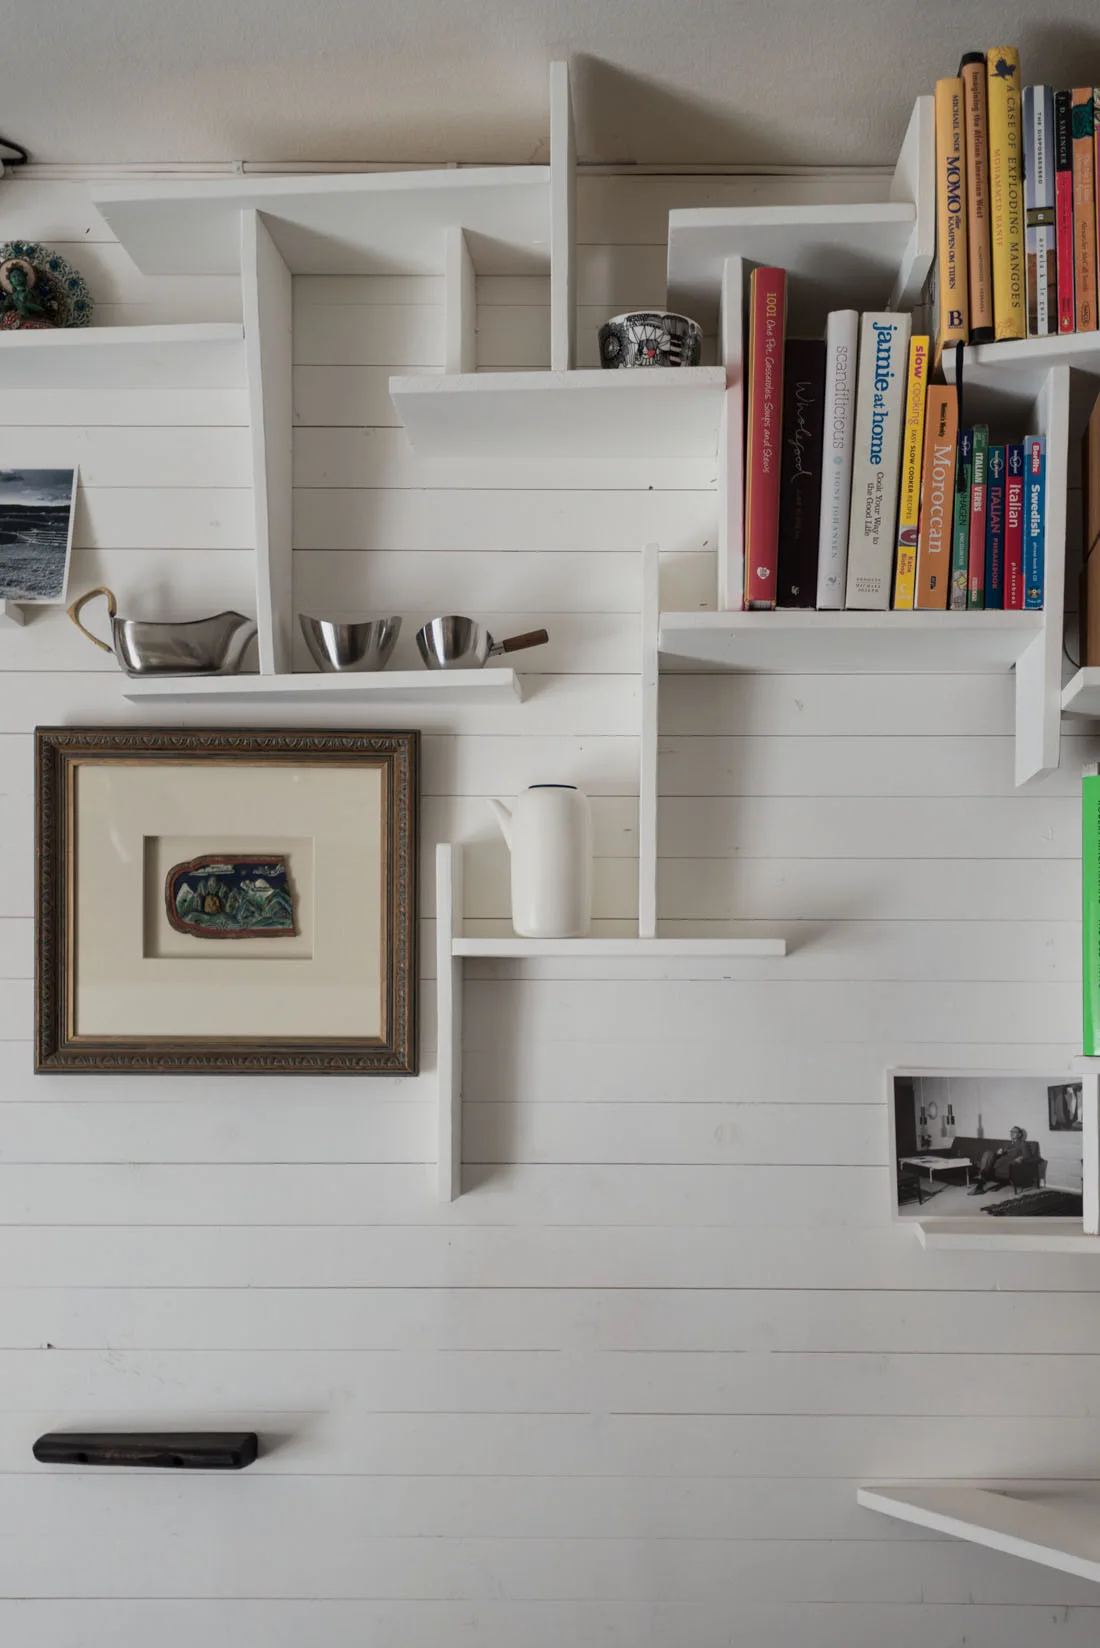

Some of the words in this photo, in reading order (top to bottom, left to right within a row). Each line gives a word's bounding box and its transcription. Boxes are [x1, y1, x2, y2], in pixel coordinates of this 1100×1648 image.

[971, 71, 981, 112] Imagining
[1006, 84, 1015, 93] A
[952, 94, 960, 130] MICHAEL
[974, 114, 983, 127] the
[1007, 97, 1016, 128] CASE
[953, 132, 961, 153] ENDE
[974, 130, 984, 158] African
[1007, 132, 1017, 149] OF
[1058, 119, 1067, 165] SALINGER
[946, 156, 962, 214] MOMO
[975, 160, 983, 197] American
[994, 149, 1003, 212] MOHAMMED
[976, 199, 984, 219] West
[1007, 157, 1019, 234] EXPLODING
[948, 216, 956, 249] KAMPEN
[995, 215, 1004, 247] HANIF
[948, 250, 956, 263] OM
[948, 265, 956, 290] TIDEN
[1009, 242, 1021, 308] MANGOES
[765, 292, 777, 317] 1001
[948, 310, 963, 326] B
[765, 319, 776, 336] One
[872, 321, 898, 392] jamie
[914, 345, 926, 379] slow
[833, 345, 850, 449] scandilicious
[873, 393, 885, 409] at
[908, 382, 924, 426] cooking
[761, 402, 774, 427] Soups
[763, 429, 773, 447] and
[788, 381, 815, 484] Wholefood
[869, 410, 889, 465] home
[762, 449, 773, 473] Stews
[909, 445, 917, 465] SLOW
[974, 452, 984, 484] ITALIAN
[1032, 445, 1040, 473] Berlitz
[867, 483, 875, 496] the
[875, 471, 885, 492] Cook
[865, 497, 874, 519] Good
[874, 495, 883, 514] Your
[906, 495, 914, 519] RECIPES
[928, 443, 953, 554] Moroccan
[973, 486, 983, 512] VERBS
[990, 486, 1002, 534] ITALIAN
[1008, 484, 1022, 528] Italian
[1030, 484, 1041, 537] Swedish
[831, 506, 840, 559] JOHANSEN
[864, 520, 873, 537] Life
[871, 517, 882, 534] Way
[872, 537, 880, 545] to
[991, 537, 999, 589] PHRASEBOOK
